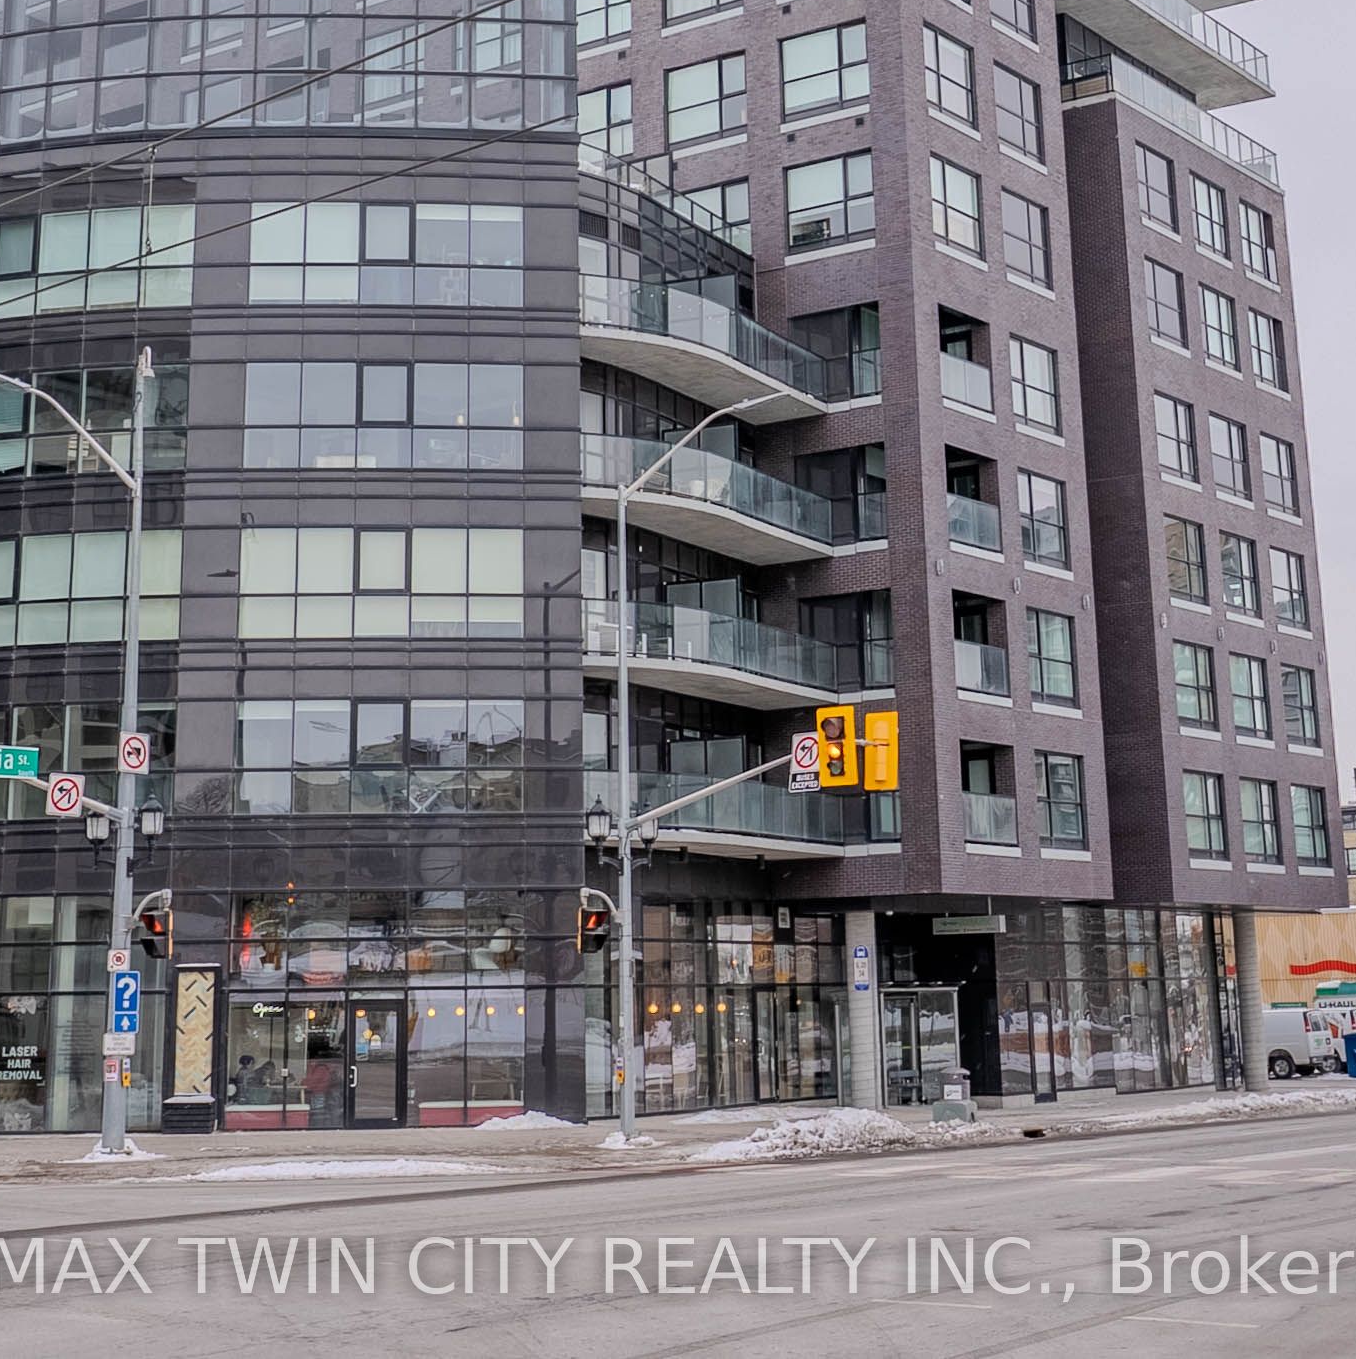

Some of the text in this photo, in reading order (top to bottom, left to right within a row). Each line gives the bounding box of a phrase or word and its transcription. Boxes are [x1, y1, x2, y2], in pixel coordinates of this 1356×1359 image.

[17, 754, 30, 766] St.
[252, 1002, 284, 1017] Open
[1319, 1001, 1356, 1009] U-HAUL
[1, 1046, 39, 1057] LASER
[7, 1058, 32, 1069] HAIR
